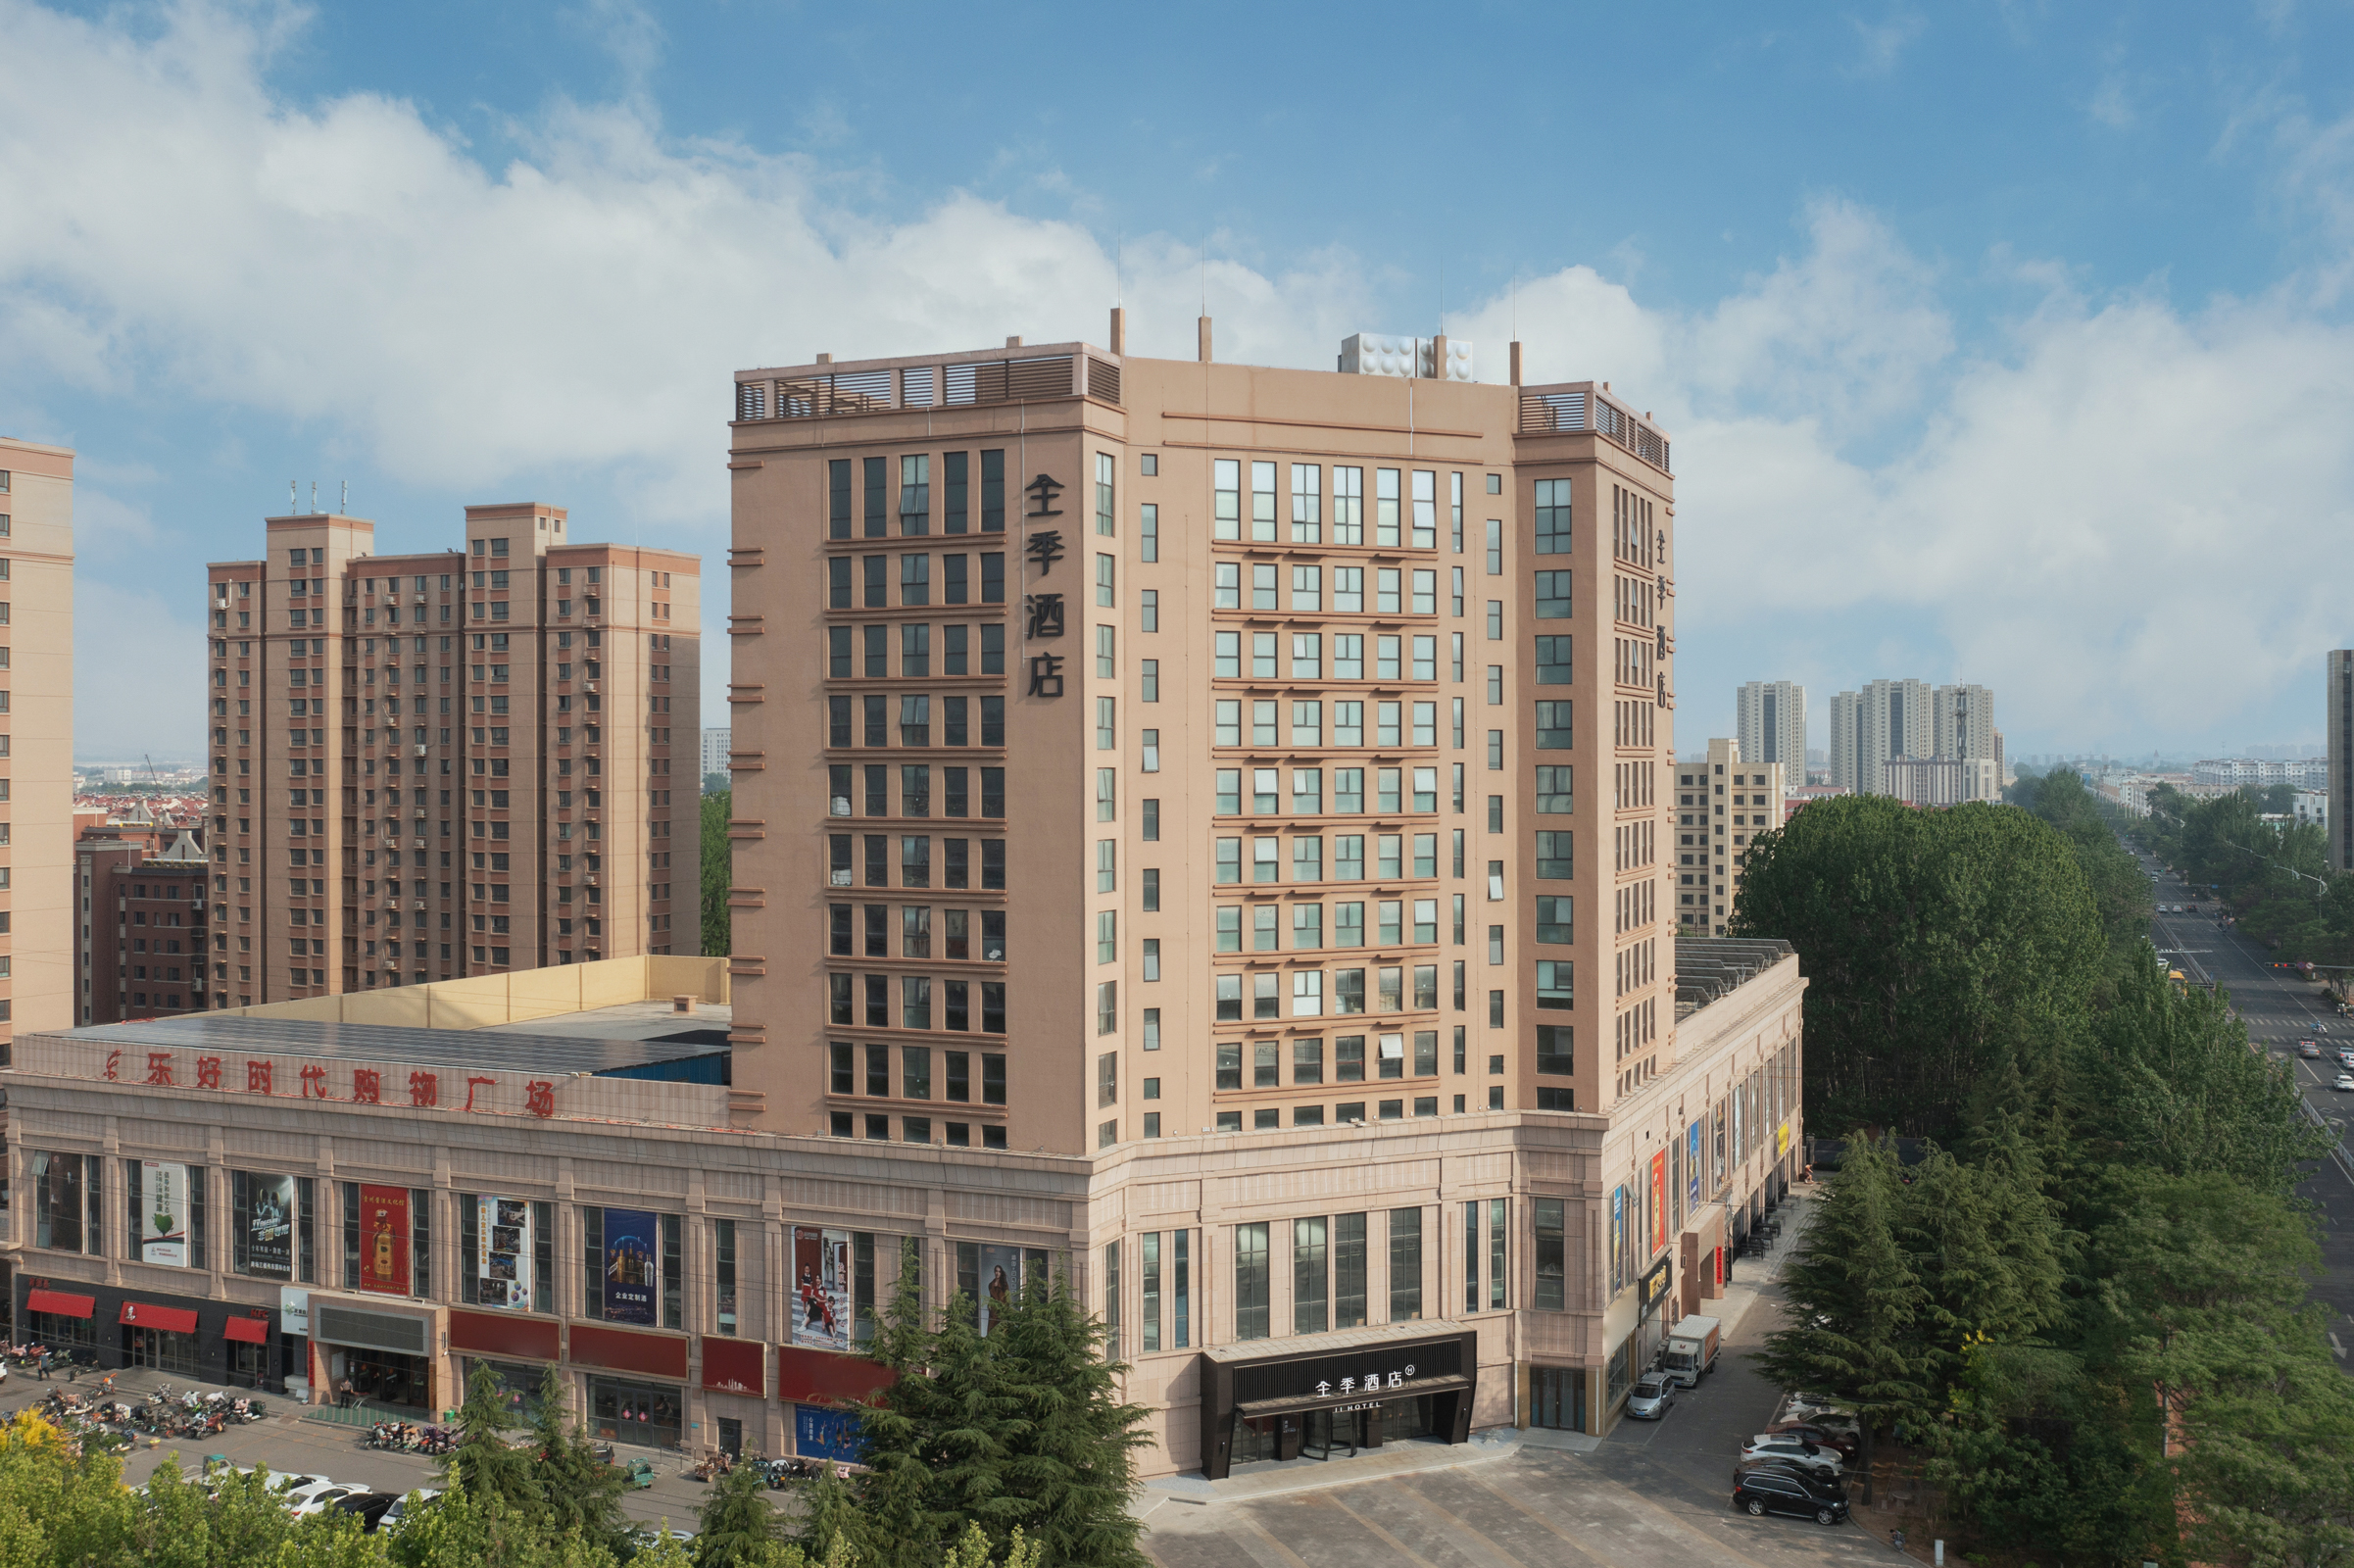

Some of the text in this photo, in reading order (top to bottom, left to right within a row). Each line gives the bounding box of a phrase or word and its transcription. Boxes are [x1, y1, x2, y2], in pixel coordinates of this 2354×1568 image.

[1025, 473, 1065, 698] 全季酒店
[147, 1053, 555, 1118] 乐好时代购物广场
[614, 1291, 648, 1302] 企业定制酒
[250, 1307, 270, 1319] KFC
[1315, 1370, 1402, 1398] 全季酒店
[1347, 1401, 1381, 1412] HOTEL
